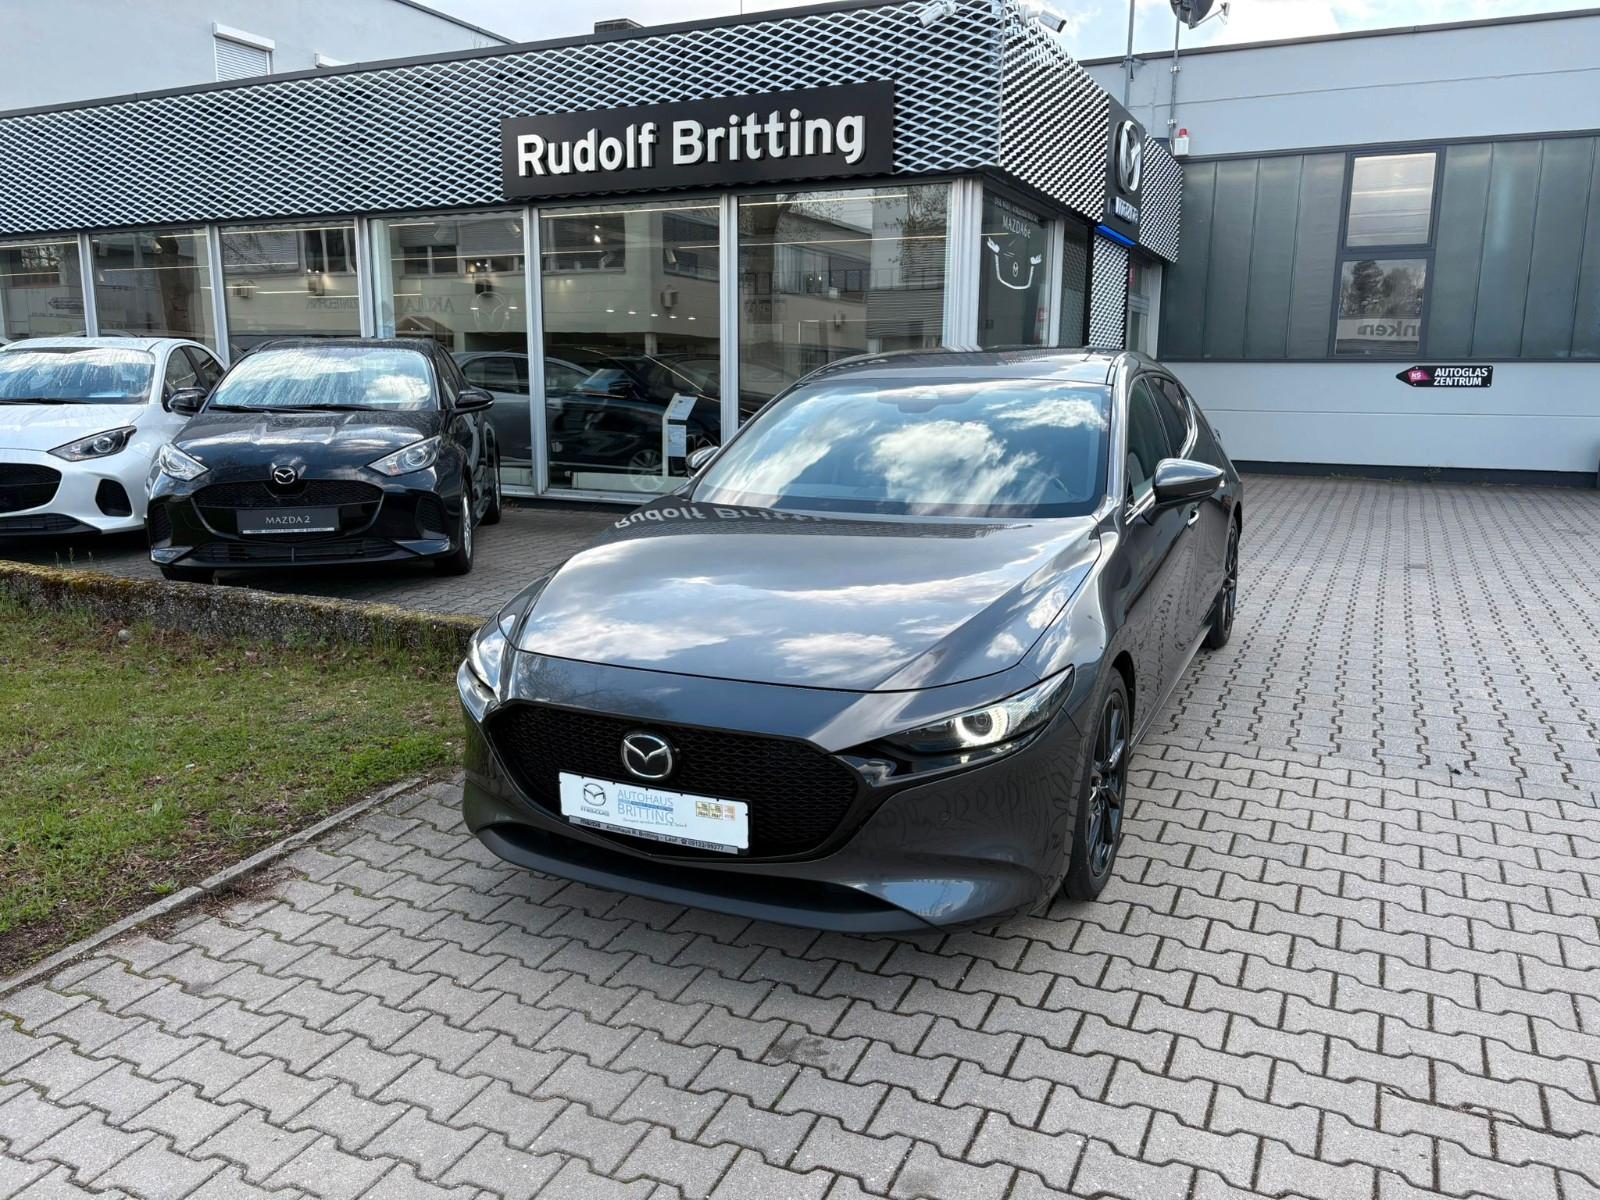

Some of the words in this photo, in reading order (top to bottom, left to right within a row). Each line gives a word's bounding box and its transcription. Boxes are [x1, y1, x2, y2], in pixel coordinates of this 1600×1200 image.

[517, 121, 658, 177] Rudolf
[673, 108, 865, 165] Britting
[1434, 367, 1488, 377] AUTOGLAS
[1433, 377, 1482, 386] ZENTRUM
[265, 516, 303, 524] MAZDA
[304, 515, 311, 523] 2
[617, 788, 674, 806] AUTOHAUS
[617, 804, 675, 823] BRITTING
